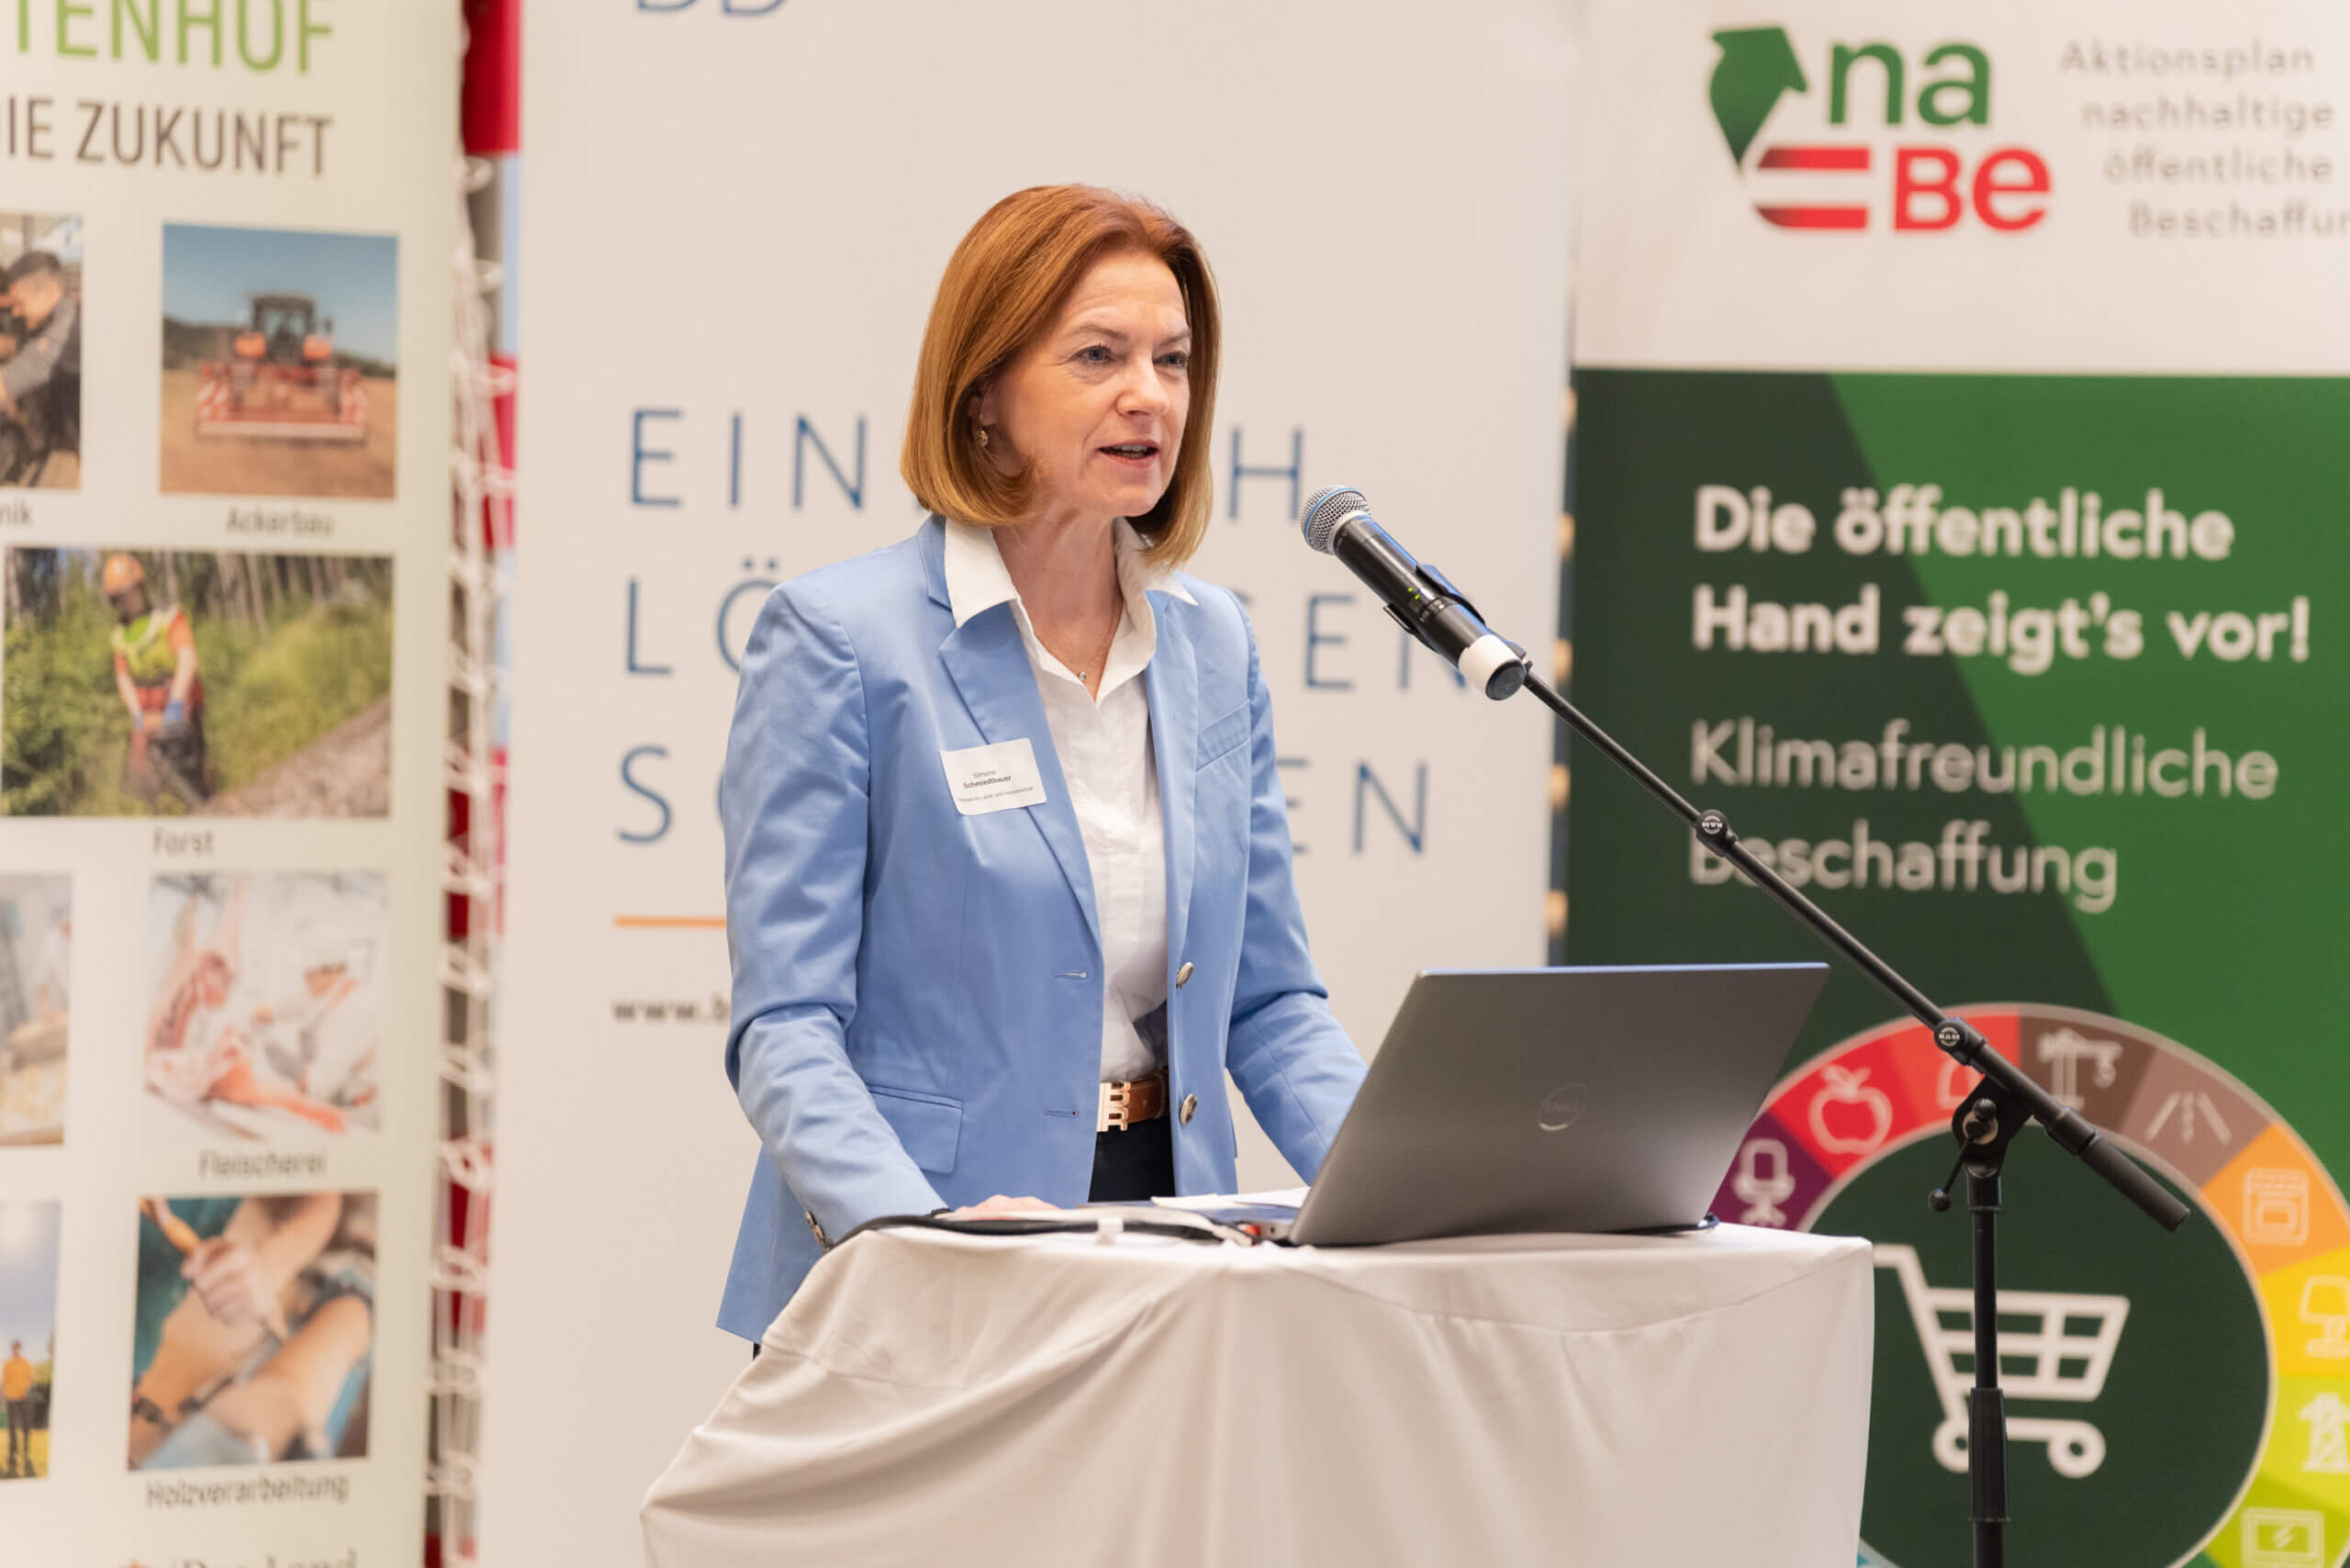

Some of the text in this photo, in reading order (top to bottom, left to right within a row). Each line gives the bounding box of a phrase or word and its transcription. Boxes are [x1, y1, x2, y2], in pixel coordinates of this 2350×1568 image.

[2061, 39, 2314, 83] Aktionsplan
[1829, 41, 1991, 127] na
[75, 98, 334, 177] ZUKUNFT
[2080, 92, 2334, 138] nachhaltige
[2104, 145, 2333, 185] öffentliche
[226, 506, 335, 536] Ackerbau
[1695, 483, 2235, 560] Die öffentliche
[1693, 583, 2311, 676] Hand zeigt's vor!
[1691, 716, 2279, 801] Klimafreundliche
[151, 828, 215, 857] Forst
[197, 1148, 328, 1179] Fleischerei
[145, 1474, 349, 1509] Holzverarbeitung
